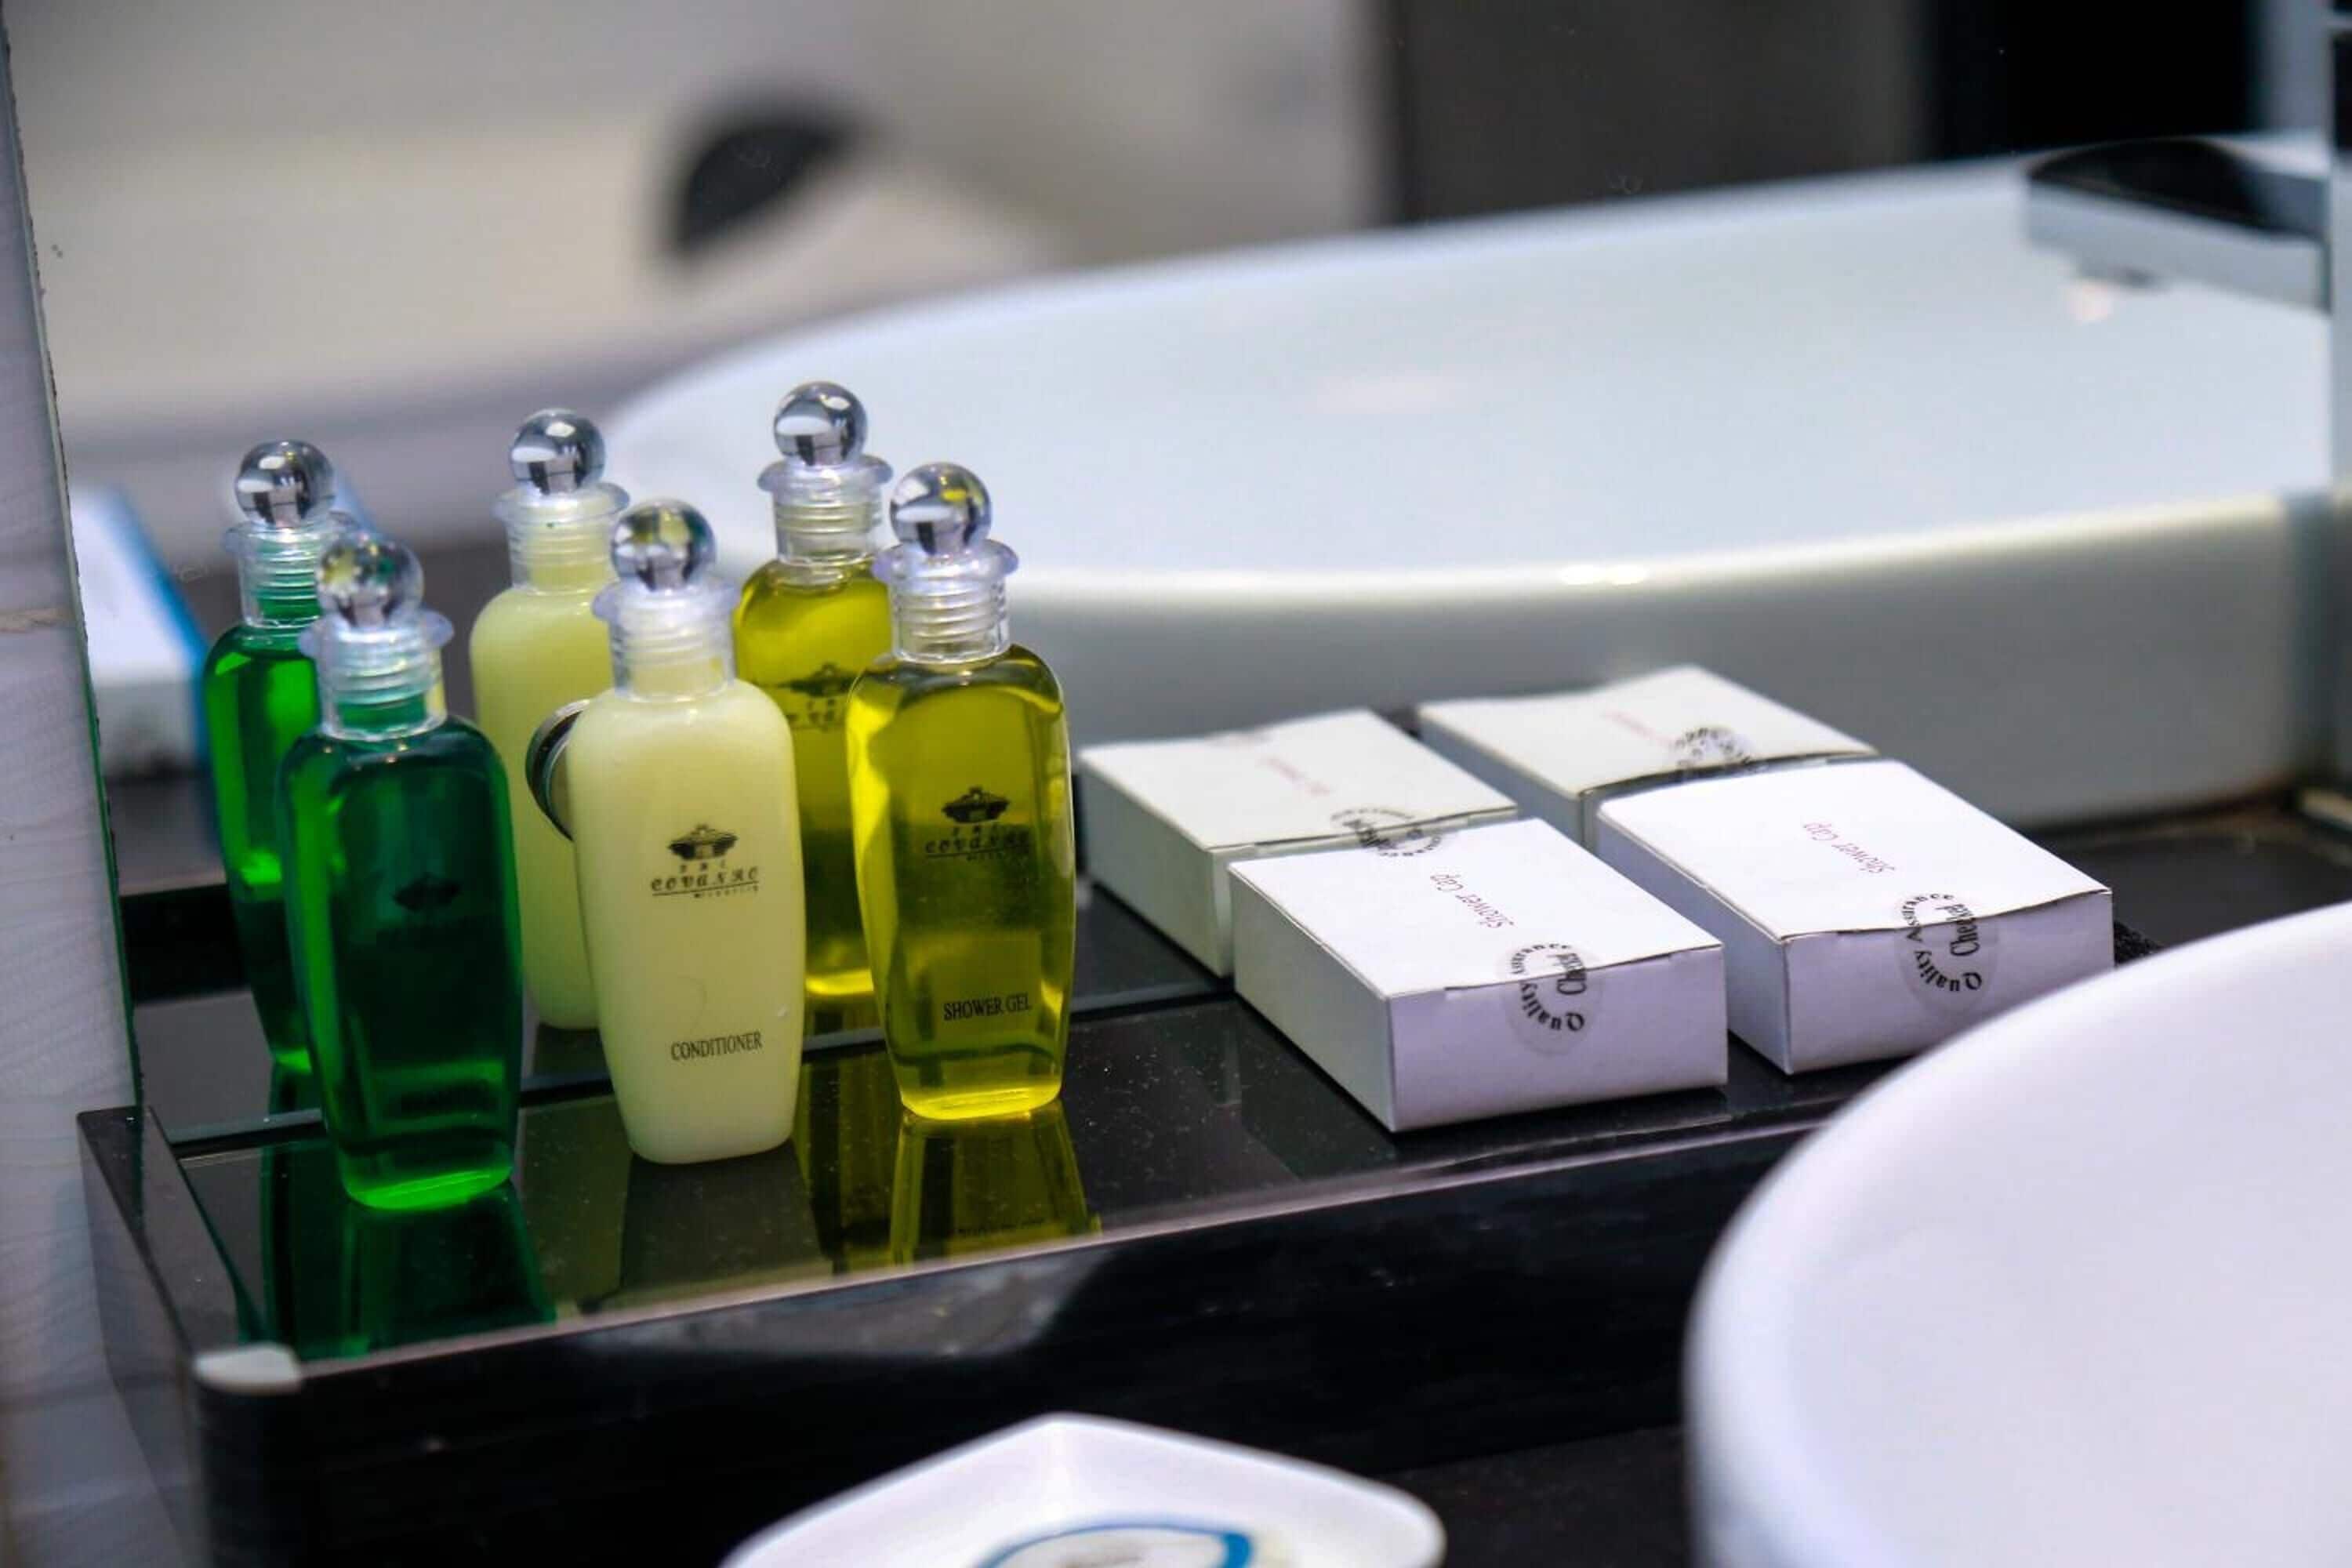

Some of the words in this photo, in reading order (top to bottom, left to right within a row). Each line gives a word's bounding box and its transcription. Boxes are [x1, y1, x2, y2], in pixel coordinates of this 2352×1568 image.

[1802, 822, 1838, 841] Cap
[1831, 842, 1896, 873] Shower
[1428, 873, 1465, 891] Cap
[1455, 894, 1515, 929] Shower
[1914, 949, 1983, 992] Quality
[943, 996, 1004, 1022] SHOWER
[1006, 993, 1033, 1012] GEL
[1519, 981, 1585, 1032] Quality
[670, 1031, 763, 1061] CONDITIONER
